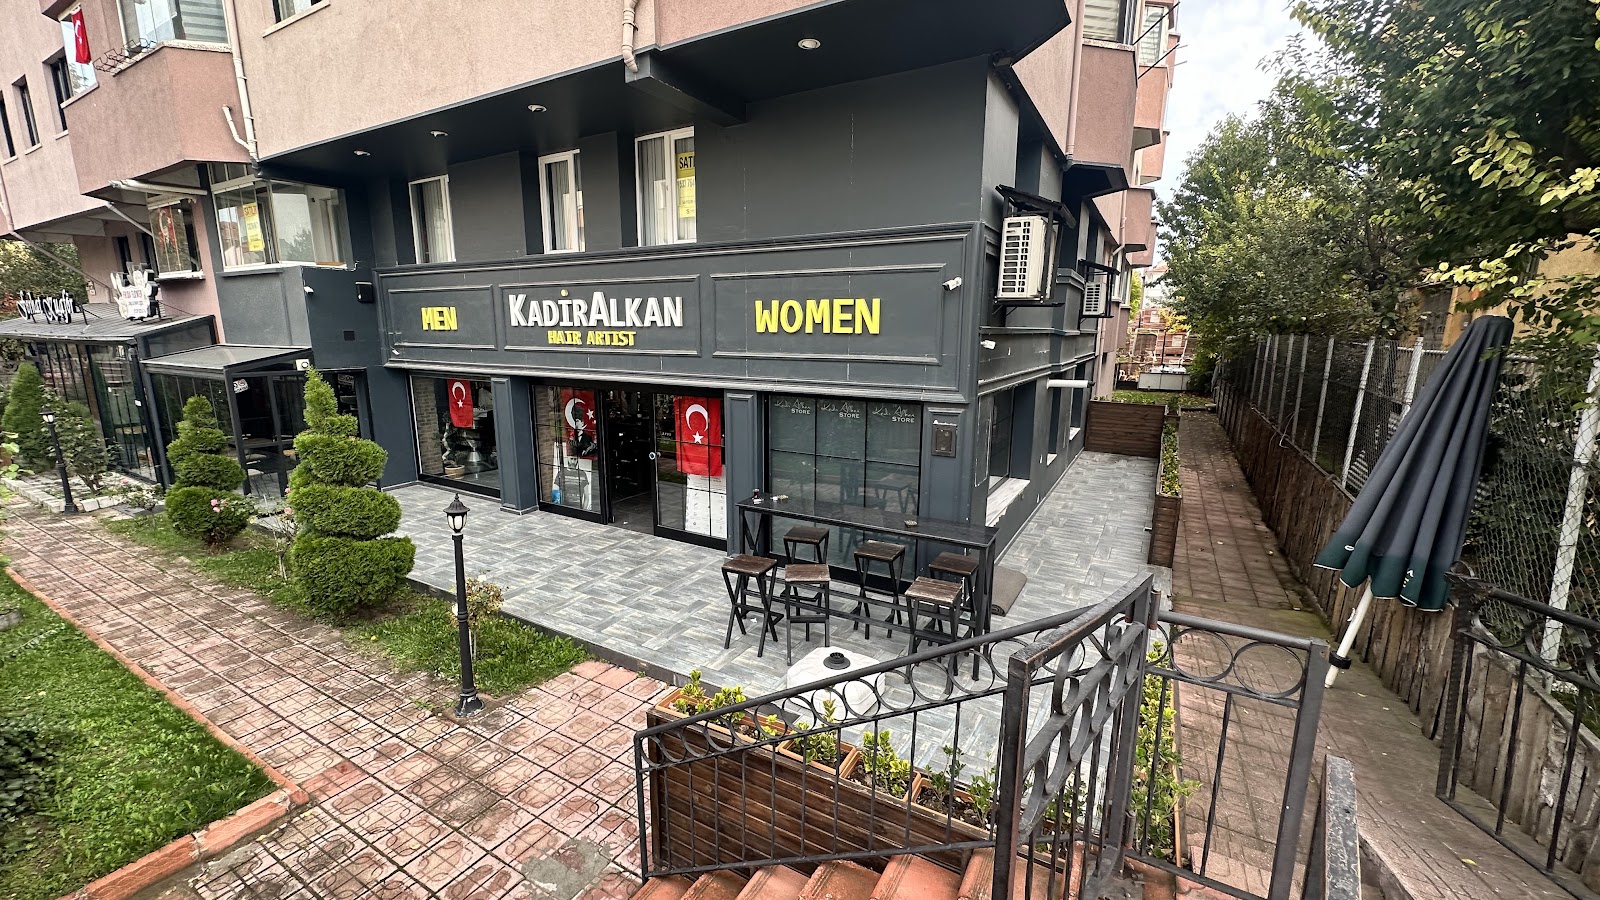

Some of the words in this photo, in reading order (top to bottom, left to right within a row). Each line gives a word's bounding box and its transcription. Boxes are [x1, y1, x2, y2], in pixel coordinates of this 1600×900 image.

[421, 306, 458, 331] MEN
[755, 298, 881, 335] WOMEN
[547, 331, 582, 345] HAIR
[587, 331, 637, 346] ARTIST
[839, 411, 860, 419] STORE
